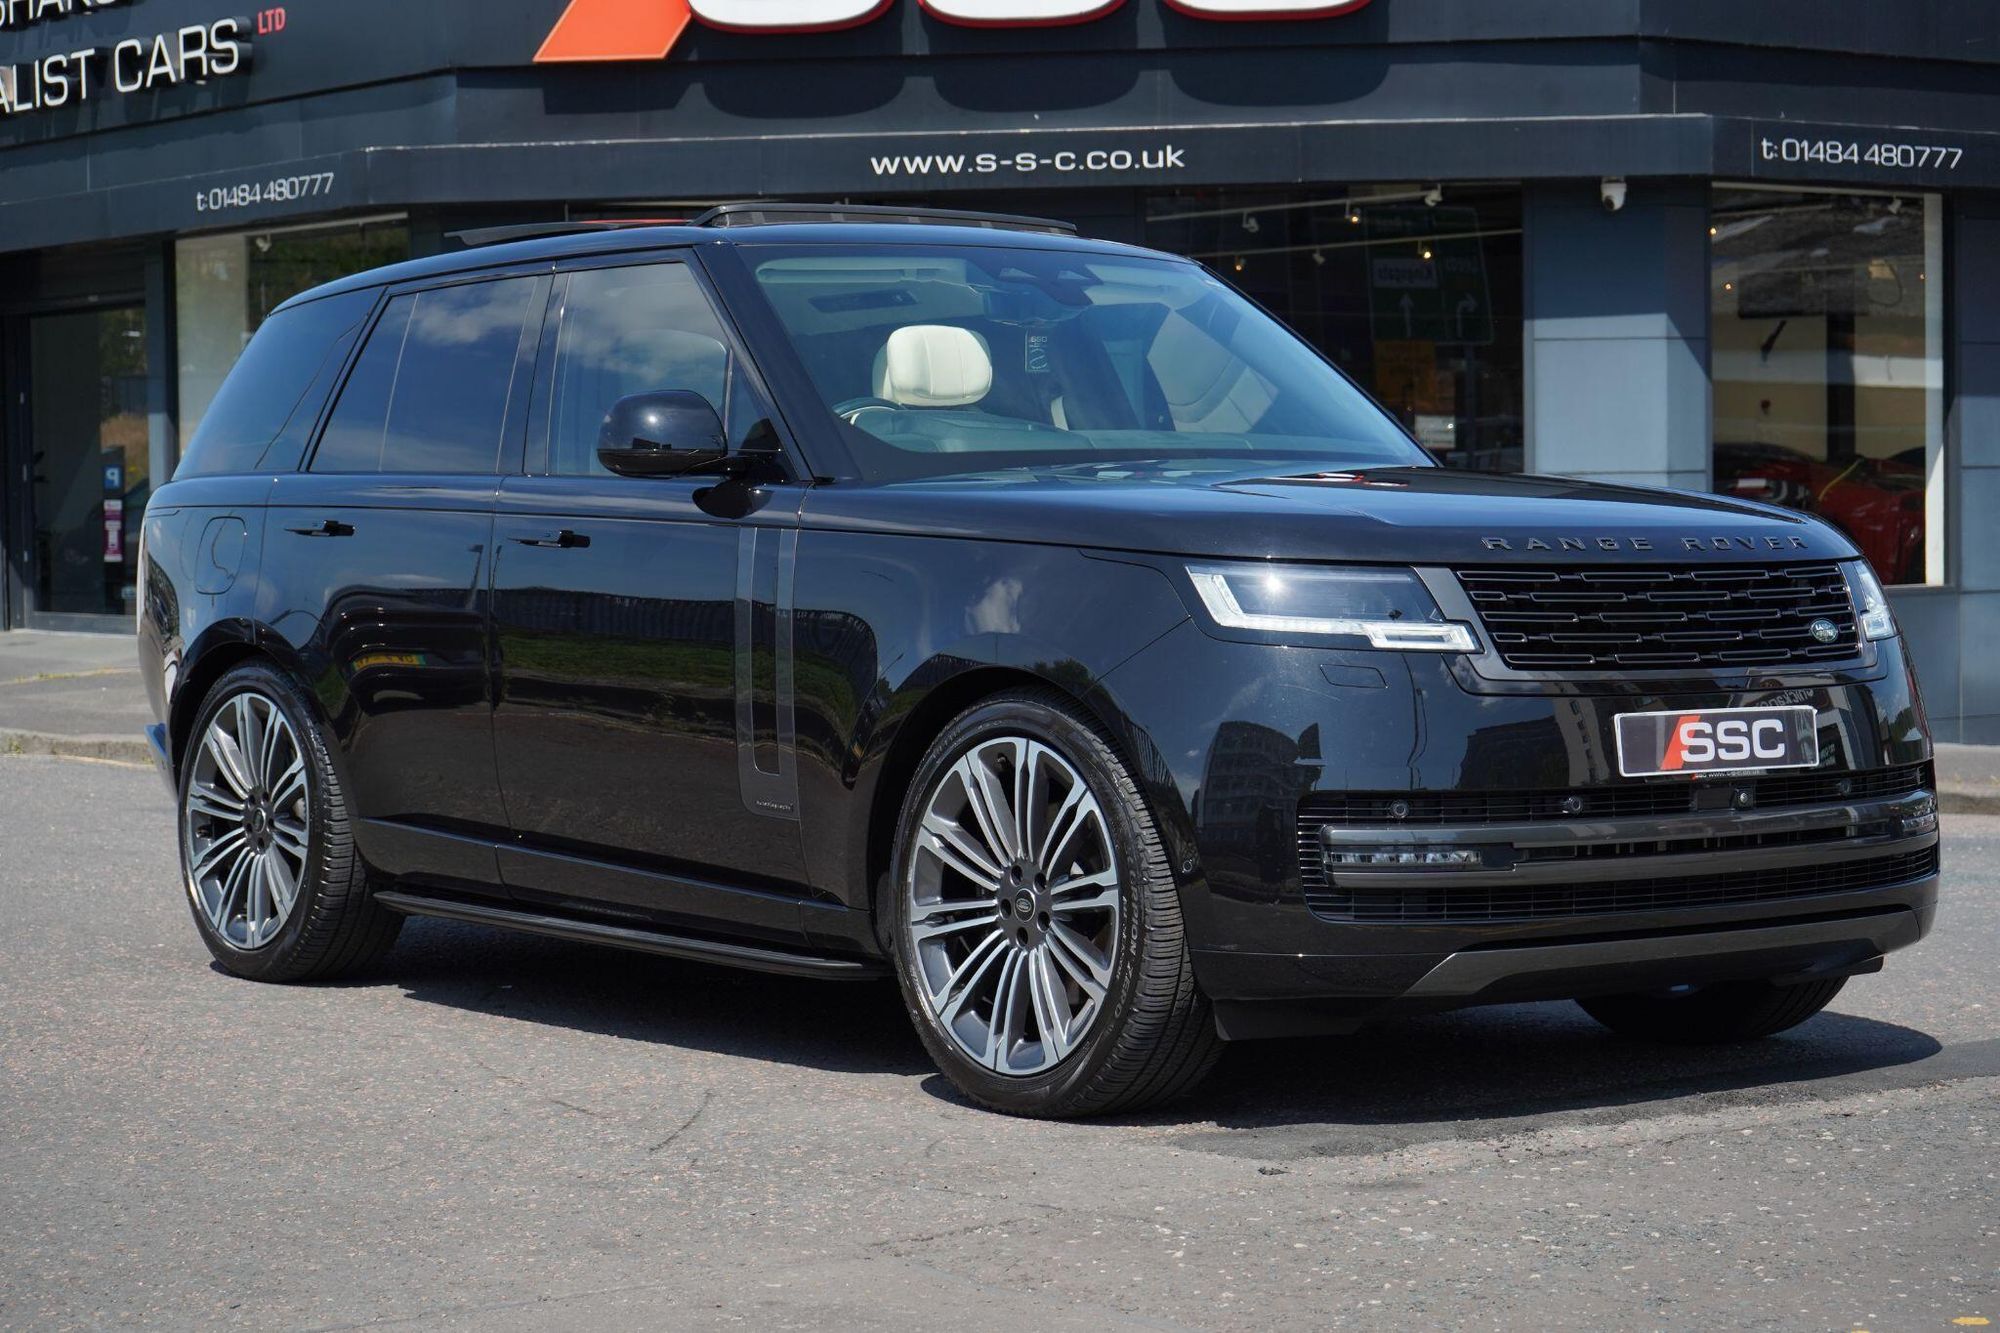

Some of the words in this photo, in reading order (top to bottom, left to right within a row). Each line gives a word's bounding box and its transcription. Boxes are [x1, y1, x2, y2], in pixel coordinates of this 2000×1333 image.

[114, 18, 238, 93] CARS
[257, 8, 286, 35] LTD
[870, 145, 1186, 175] www.s-s-c.co.uk
[1761, 137, 1859, 164] t:01484
[1863, 143, 1963, 169] 480777
[197, 183, 261, 211] t:01484
[263, 172, 335, 202] 480777
[1480, 536, 1653, 551] RANGE
[1679, 535, 1809, 551] ROVER
[1679, 718, 1786, 763] SSC
